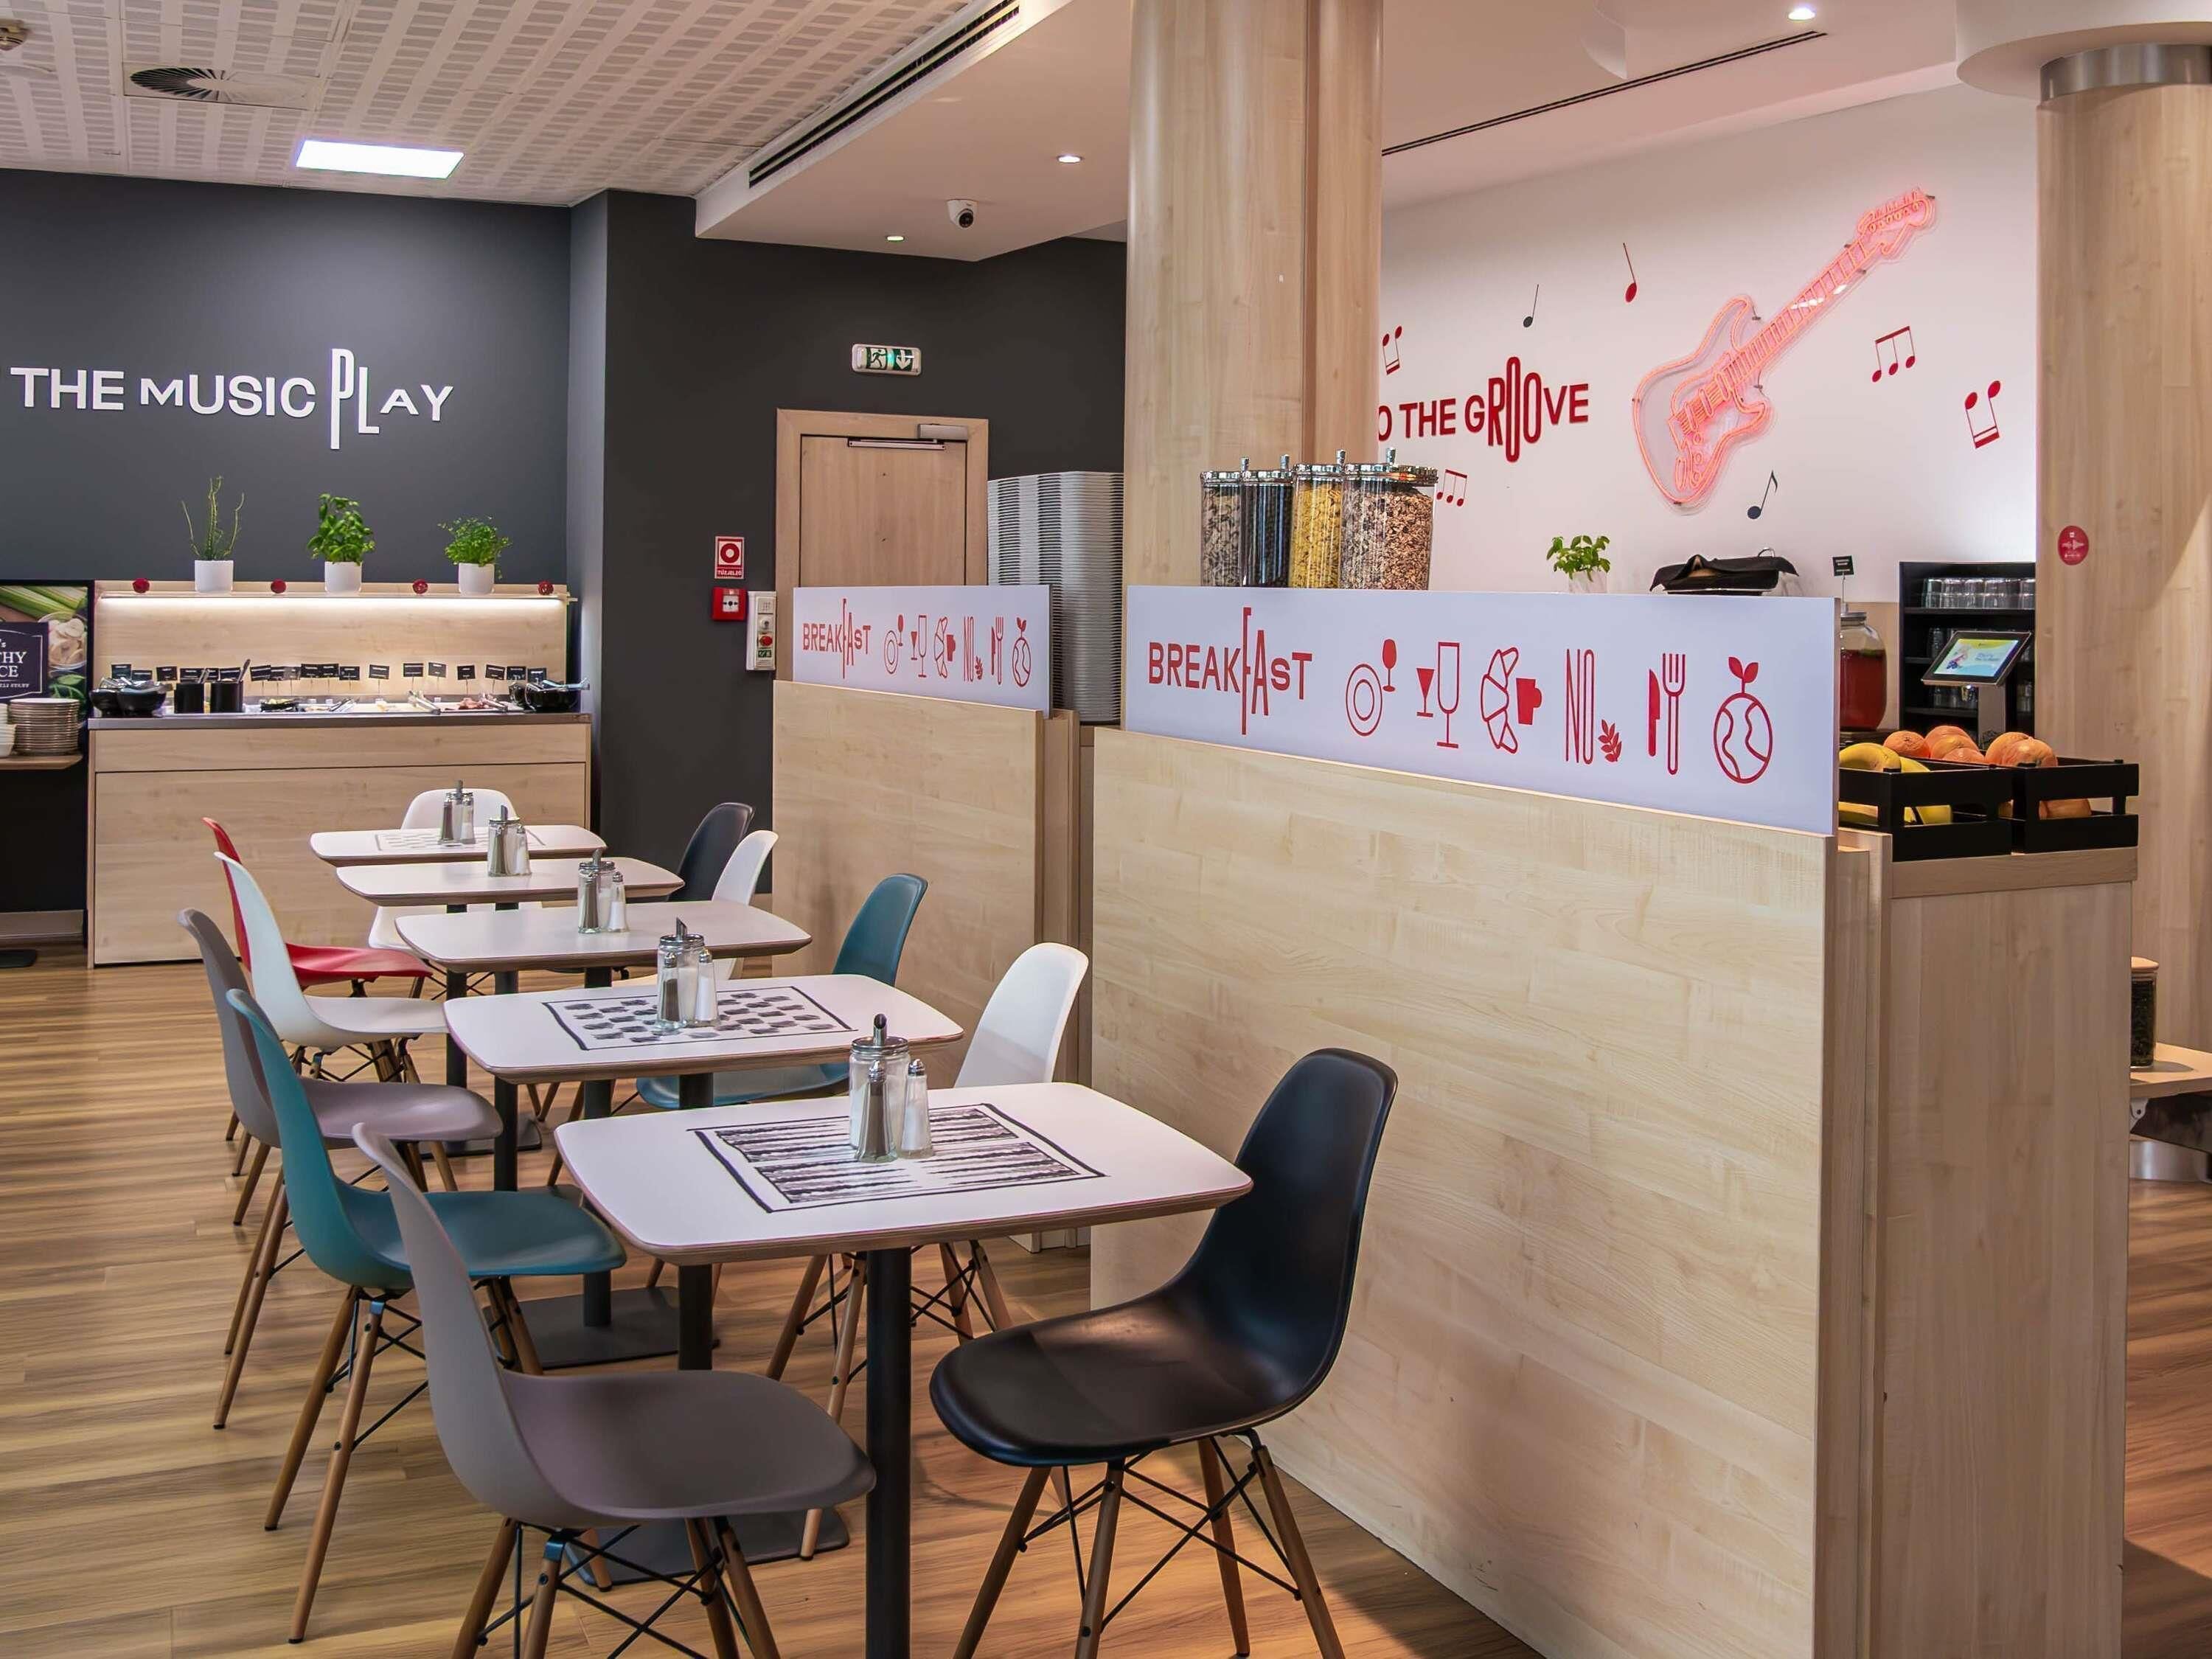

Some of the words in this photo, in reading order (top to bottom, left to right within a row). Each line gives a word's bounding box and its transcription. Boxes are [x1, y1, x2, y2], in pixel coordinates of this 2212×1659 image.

[10, 367, 124, 410] THE
[140, 374, 316, 418] MUSIC
[330, 348, 453, 450] PLAY
[1399, 398, 1456, 438] THE
[1464, 357, 1589, 462] GROOVE
[802, 598, 871, 679] BREAKFAST
[1149, 607, 1312, 735] BREAKFAST
